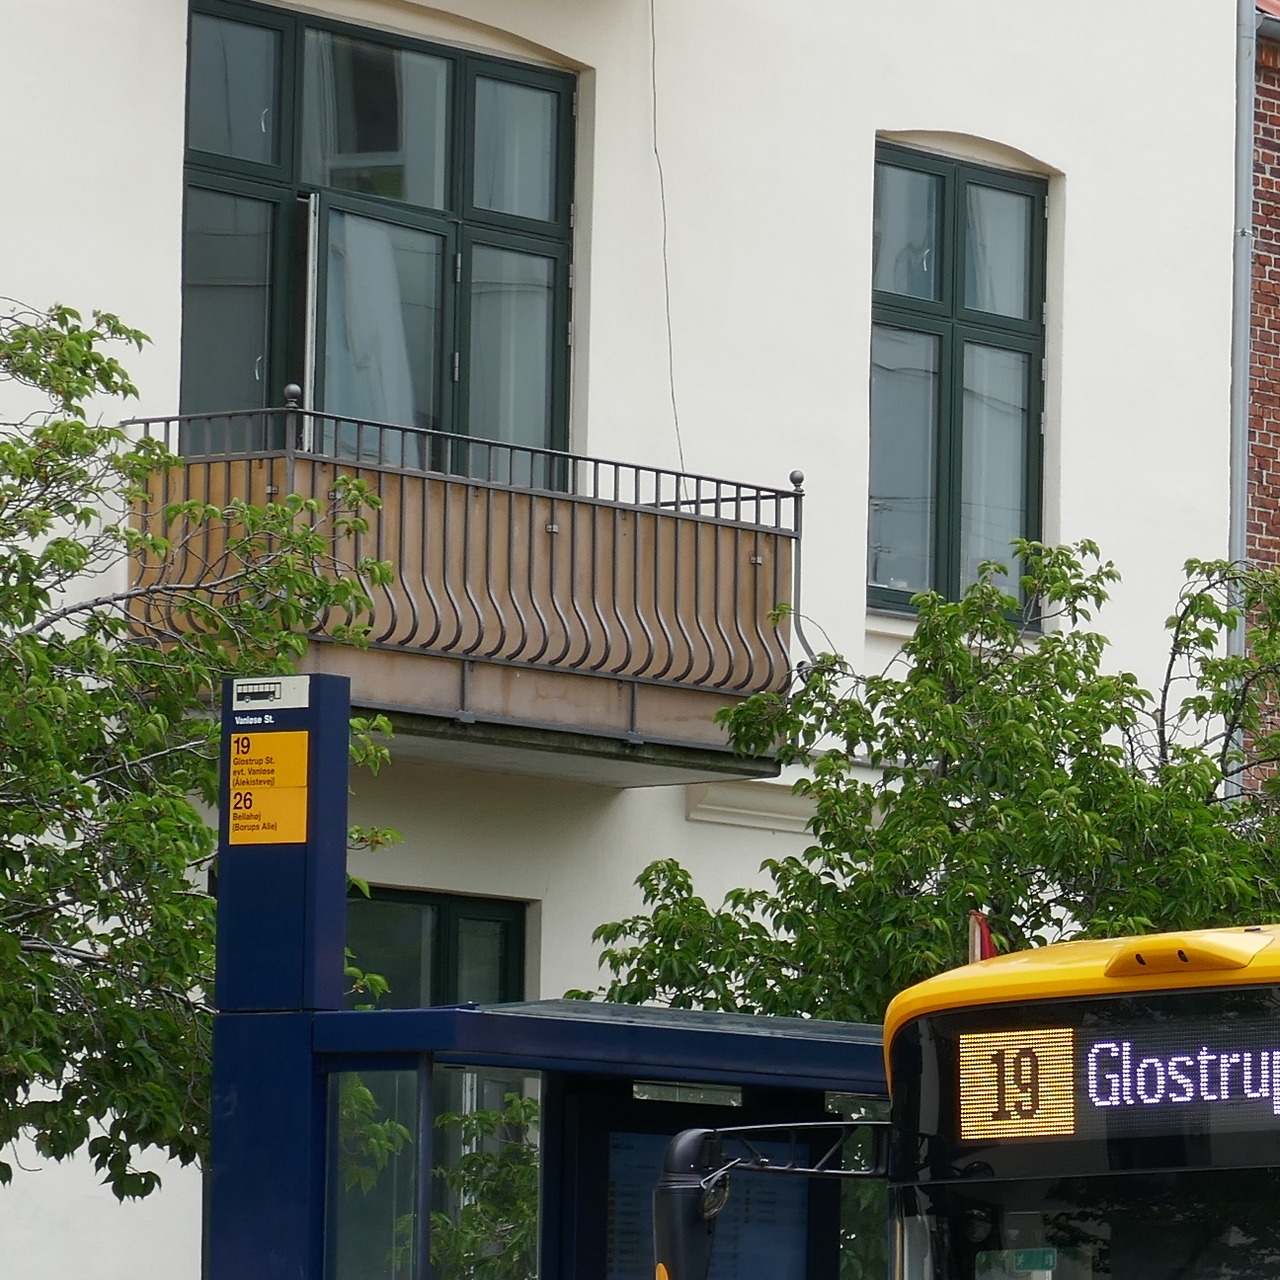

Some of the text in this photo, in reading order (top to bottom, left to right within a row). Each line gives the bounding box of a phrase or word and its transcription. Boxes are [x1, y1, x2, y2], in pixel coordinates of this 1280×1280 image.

[233, 736, 251, 755] 19
[233, 756, 275, 767] Glostrup St.
[232, 791, 253, 810] 26
[988, 1046, 1042, 1122] 19
